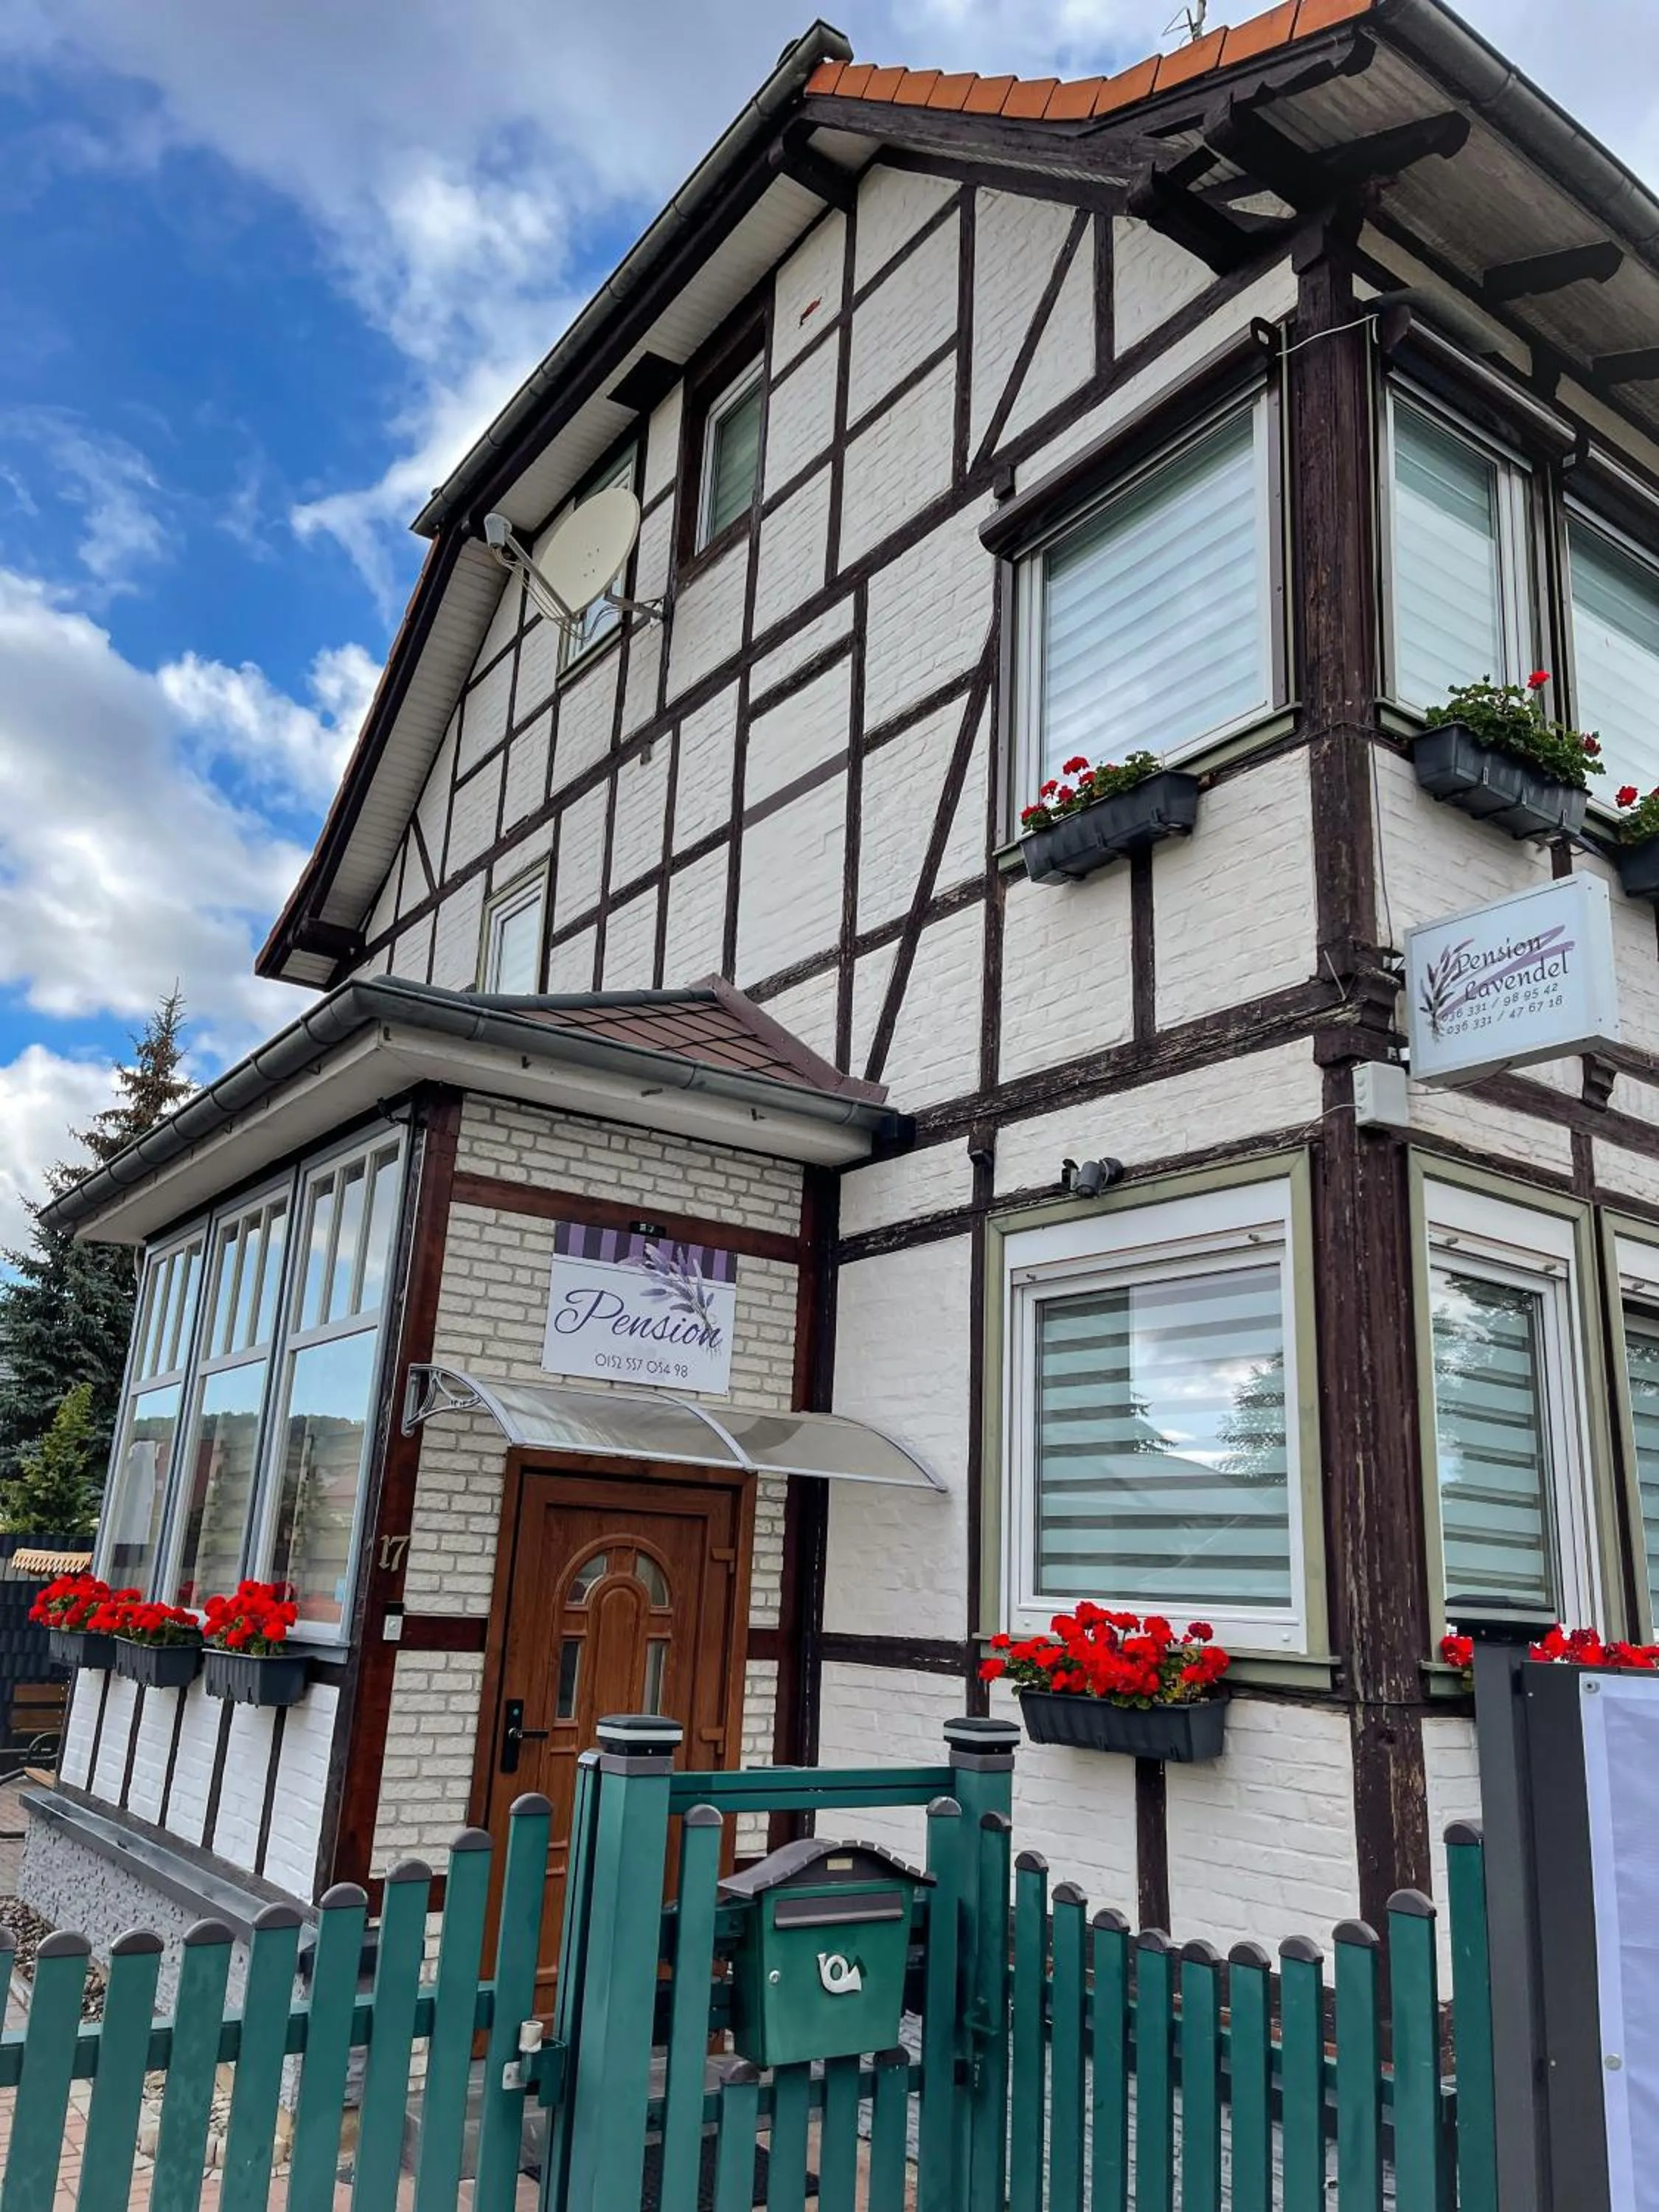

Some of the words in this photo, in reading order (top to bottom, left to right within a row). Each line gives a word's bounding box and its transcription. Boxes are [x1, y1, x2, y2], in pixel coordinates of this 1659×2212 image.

[1457, 937, 1540, 973] Pension
[1465, 950, 1568, 1000] Lavendel
[1467, 1003, 1487, 1017] 331
[1543, 983, 1558, 995] 42
[1472, 1016, 1492, 1030] 331
[1509, 1006, 1524, 1019] 47
[1528, 1001, 1543, 1012] 67
[554, 1289, 723, 1349] Pension
[674, 1363, 688, 1378] 98
[378, 1534, 410, 1572] 17
